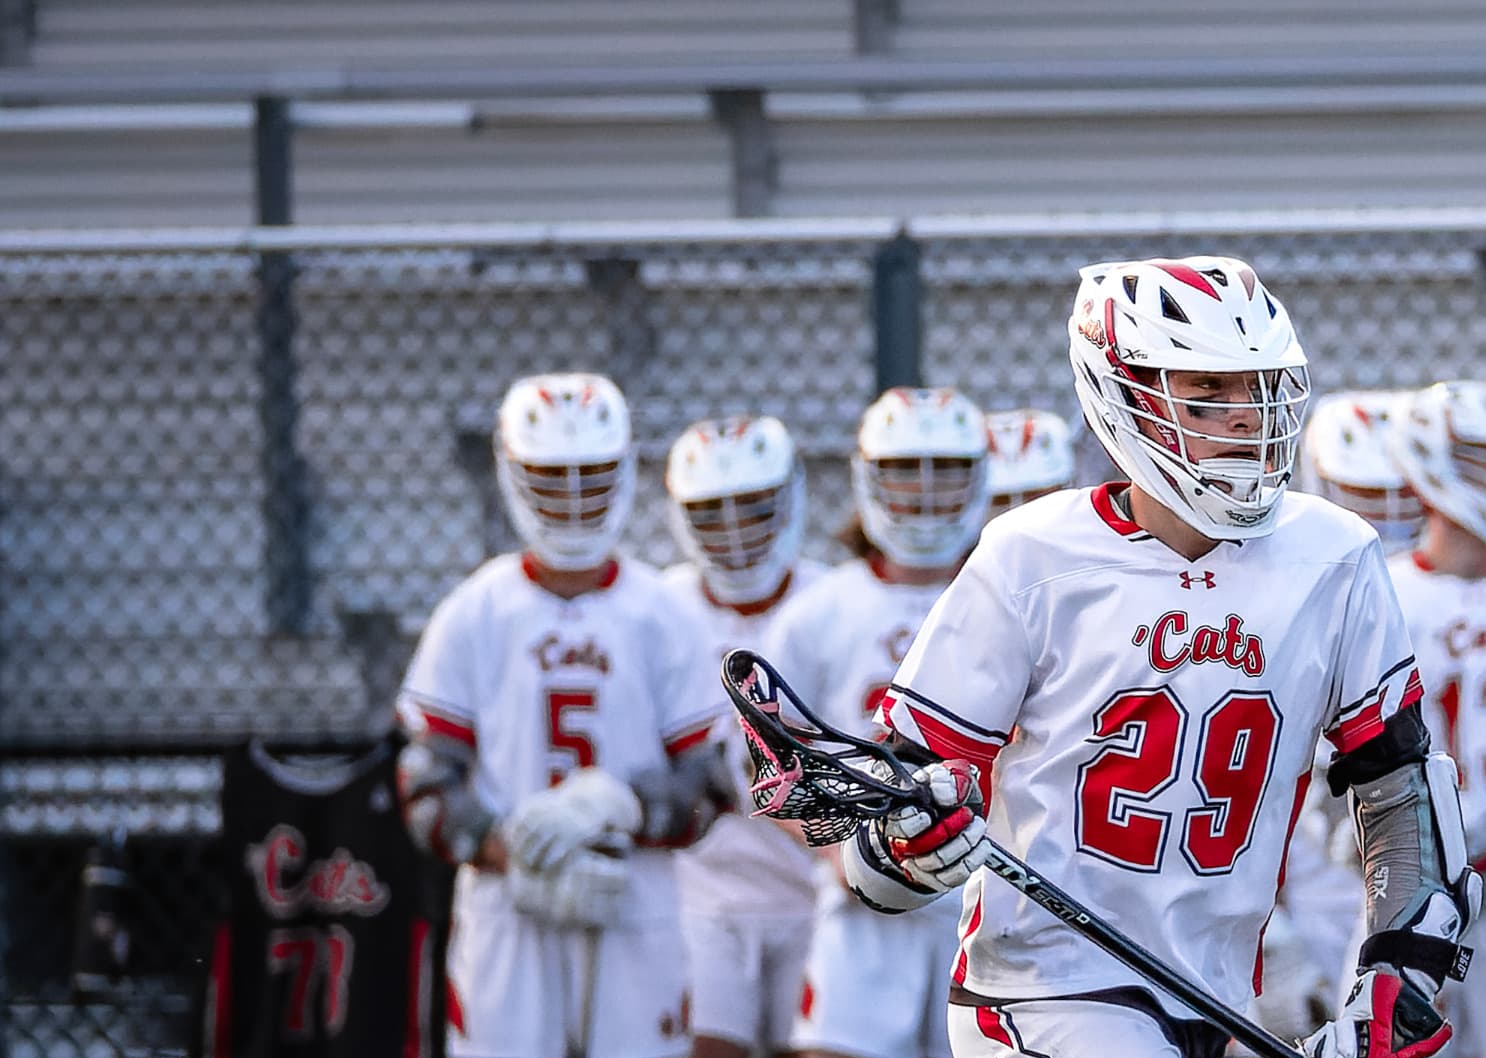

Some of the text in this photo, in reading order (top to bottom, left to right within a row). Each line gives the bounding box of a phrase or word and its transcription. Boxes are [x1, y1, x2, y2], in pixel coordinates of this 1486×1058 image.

[544, 687, 598, 789] 5
[1074, 684, 1283, 877] 29
[1373, 866, 1389, 900] STX
[268, 925, 355, 1040] 71
